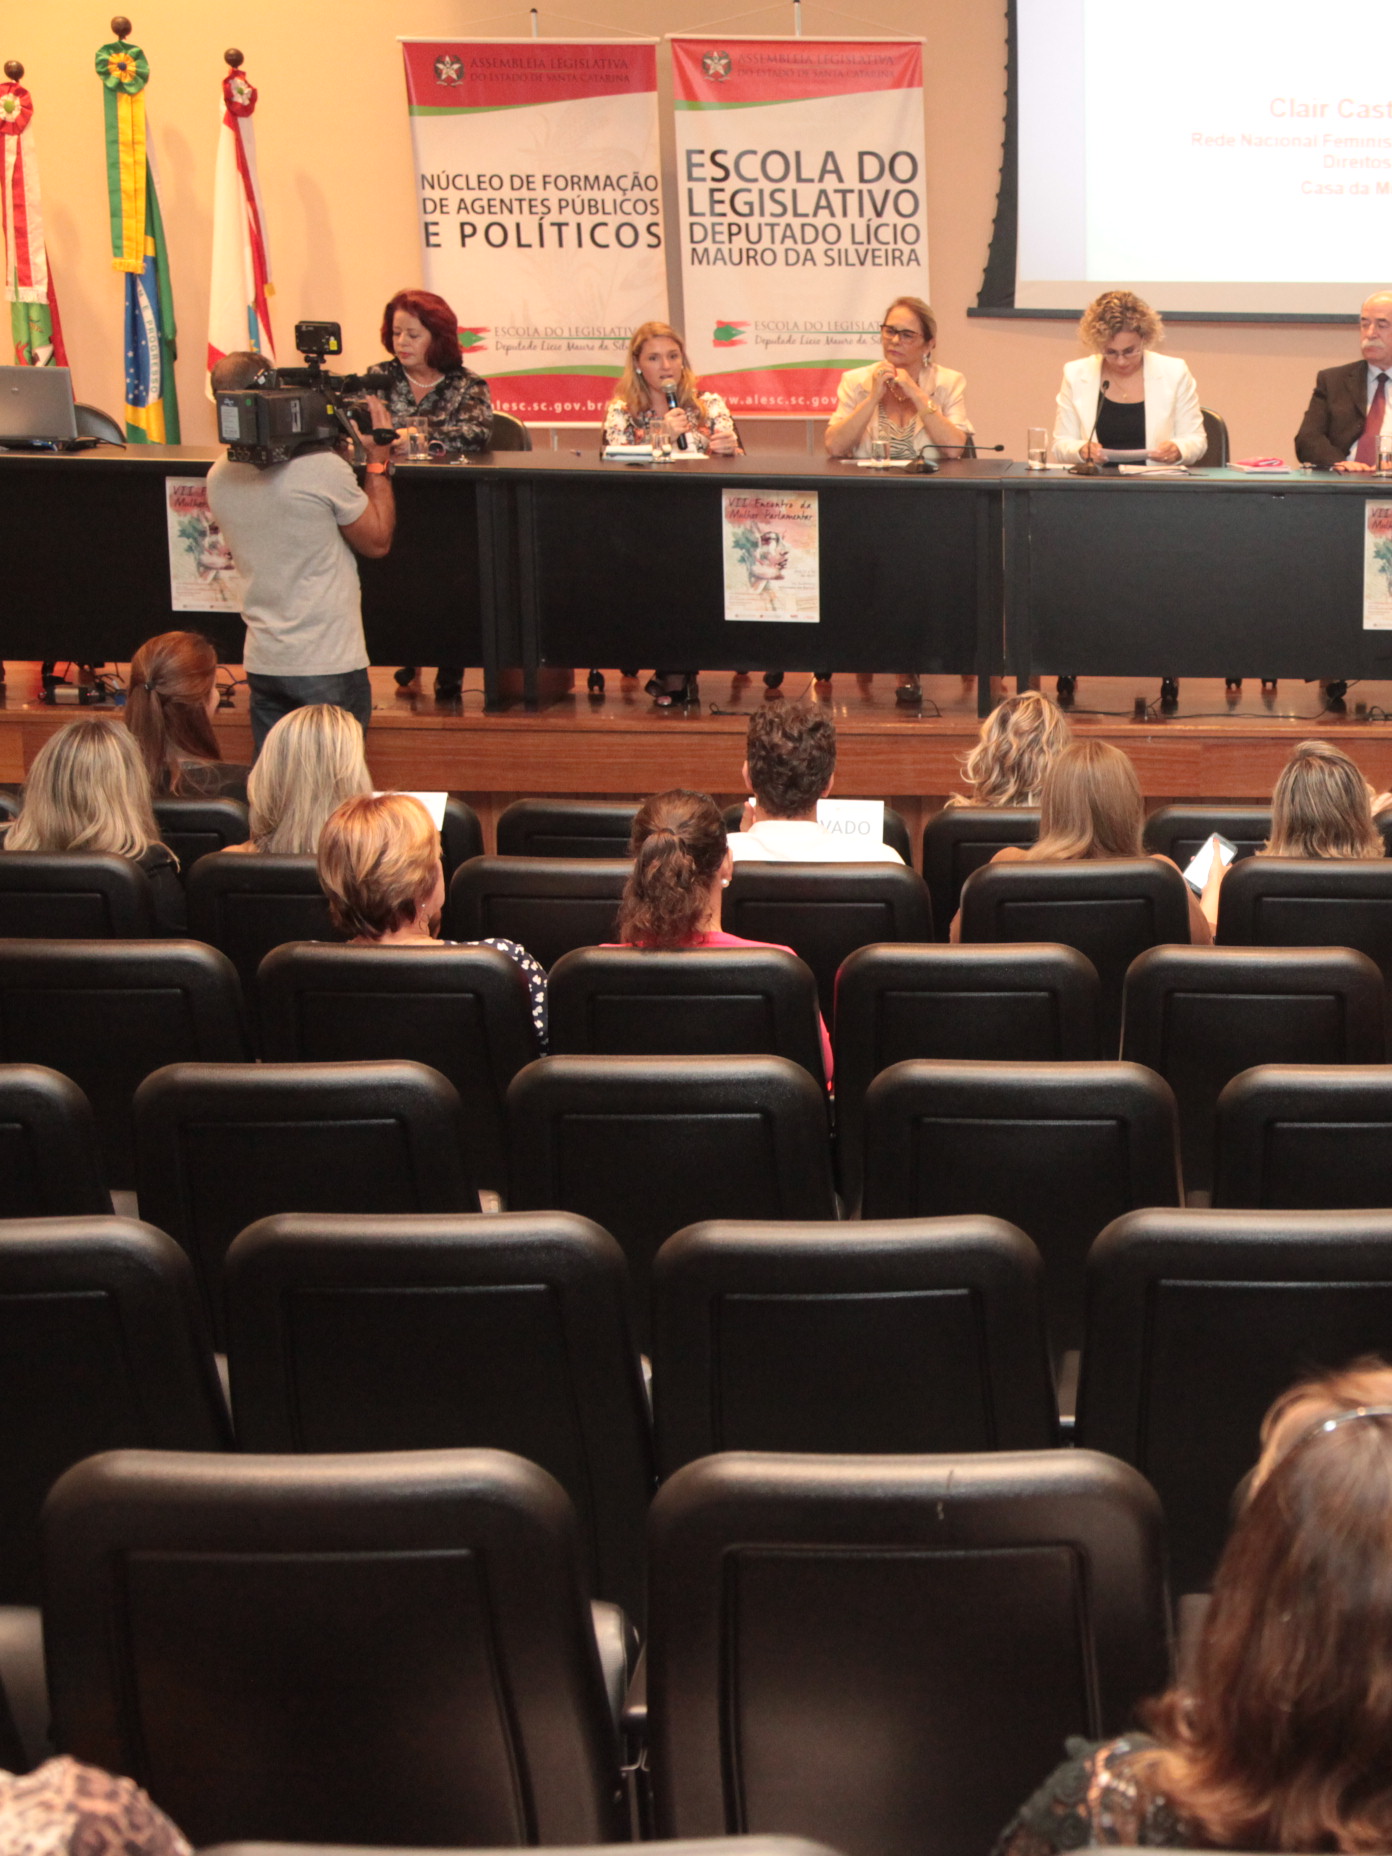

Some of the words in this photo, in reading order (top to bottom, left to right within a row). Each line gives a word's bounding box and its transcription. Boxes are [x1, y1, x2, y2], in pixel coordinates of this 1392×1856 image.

[470, 57, 546, 69] ASSEMBLEIA
[550, 58, 629, 70] LEGISLATIVA
[737, 53, 813, 65] ASSEMBLEIA
[817, 54, 895, 66] LEGISLATIVA
[546, 73, 577, 83] SANTA
[579, 73, 630, 83] CATARINA
[1269, 97, 1330, 118] Clair
[1191, 132, 1236, 147] Rede
[1240, 133, 1318, 148] Nacional
[685, 148, 845, 184] ESCOLA
[857, 150, 919, 184] DO
[1322, 154, 1392, 169] Direitos
[420, 170, 504, 191] NÚCLEO
[510, 174, 537, 191] DE
[542, 172, 659, 196] FORMAÇÃO
[1300, 180, 1344, 196] Casa
[1348, 181, 1370, 196] da
[422, 198, 449, 215] DE
[456, 197, 552, 215] AGENTES
[558, 195, 660, 216] PÚBLICOS
[687, 187, 920, 219] LEGISLATIVO
[424, 221, 442, 248] E
[459, 216, 662, 249] POLÍTICOS
[688, 222, 842, 246] DEPUTADO
[851, 218, 921, 246] LÍCIO
[691, 247, 777, 267] MAURO
[784, 247, 817, 267] DA
[824, 247, 921, 267] SILVEIRA
[494, 326, 542, 337] ESCOLA
[544, 326, 564, 337] DO
[568, 327, 636, 337] LEGISLATIV
[754, 320, 800, 331] ESCOLA
[804, 320, 823, 331] DO
[827, 321, 882, 331] LEGISLAT
[754, 498, 794, 508] Encontro
